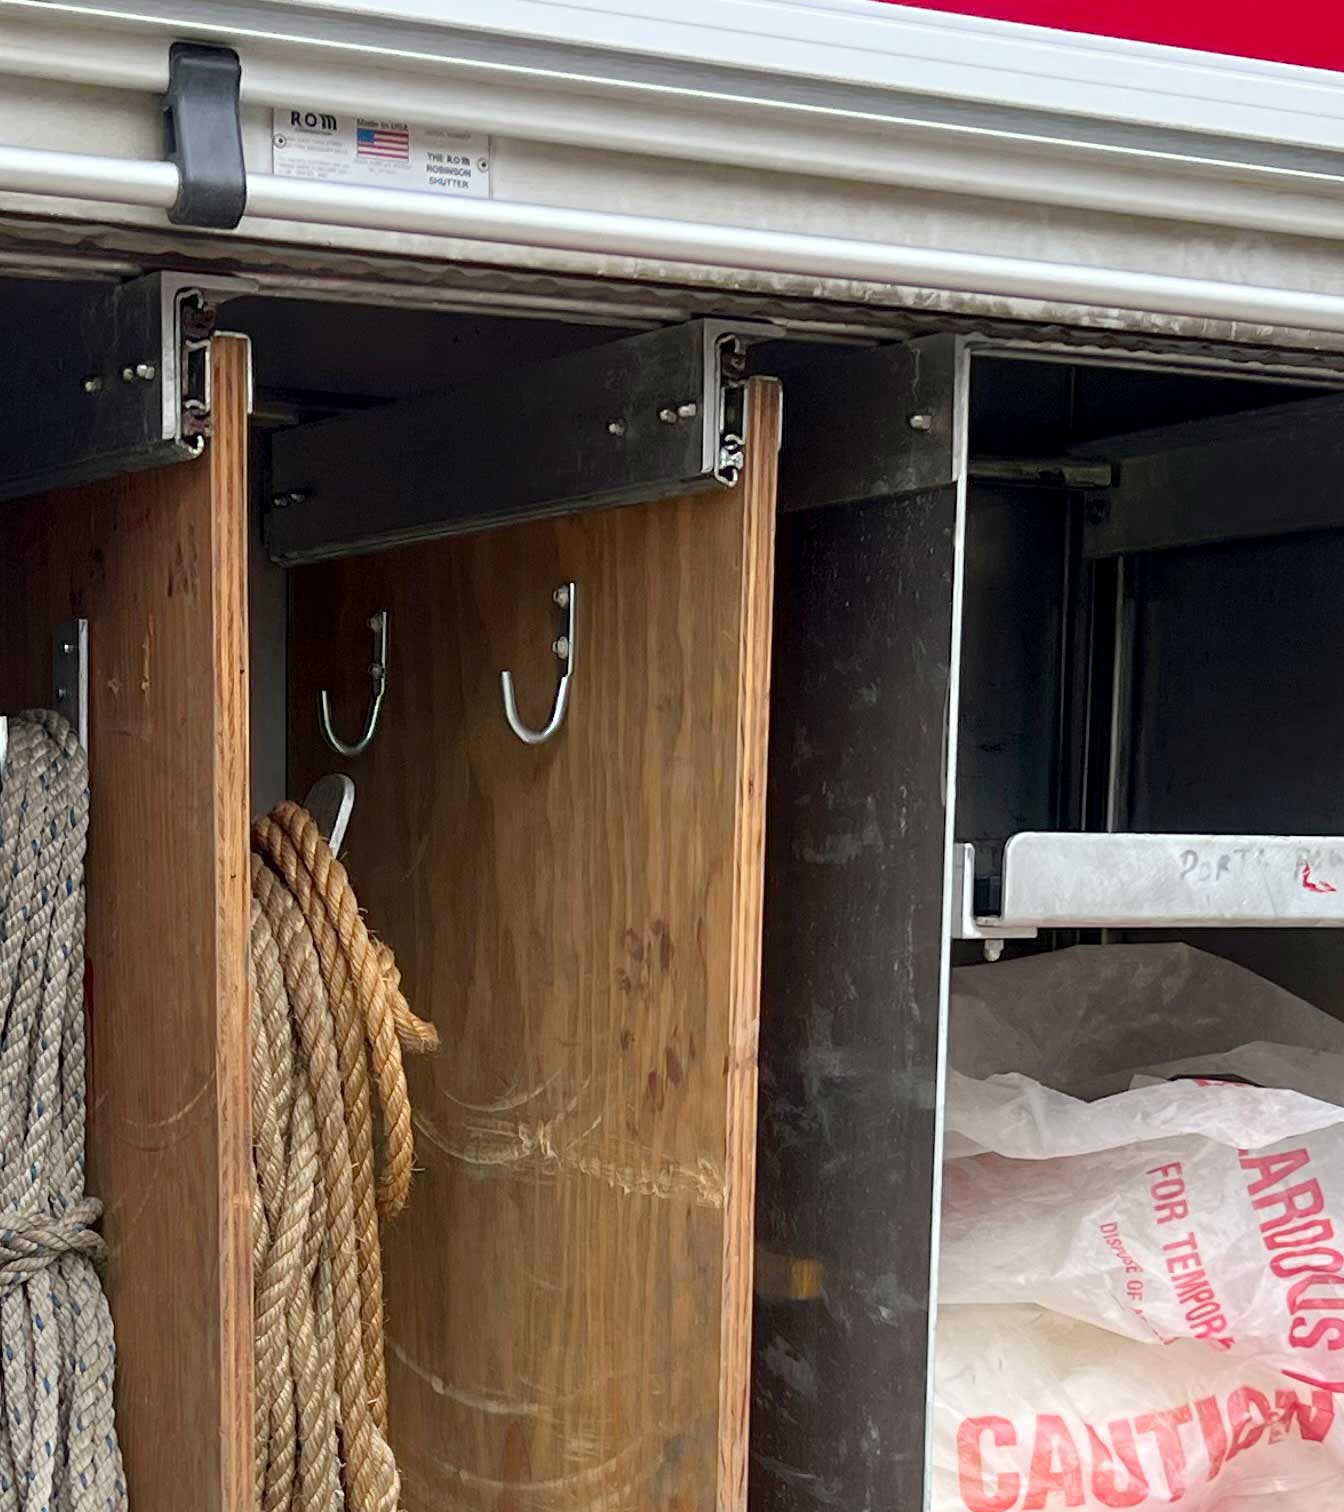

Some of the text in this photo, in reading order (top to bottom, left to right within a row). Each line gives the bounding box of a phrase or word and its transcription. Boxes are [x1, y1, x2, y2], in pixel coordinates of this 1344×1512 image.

[427, 152, 444, 161] THE
[429, 176, 469, 189] SHUTTER
[1146, 1162, 1236, 1350] FOR TEMPOR
[1126, 1280, 1144, 1301] OF
